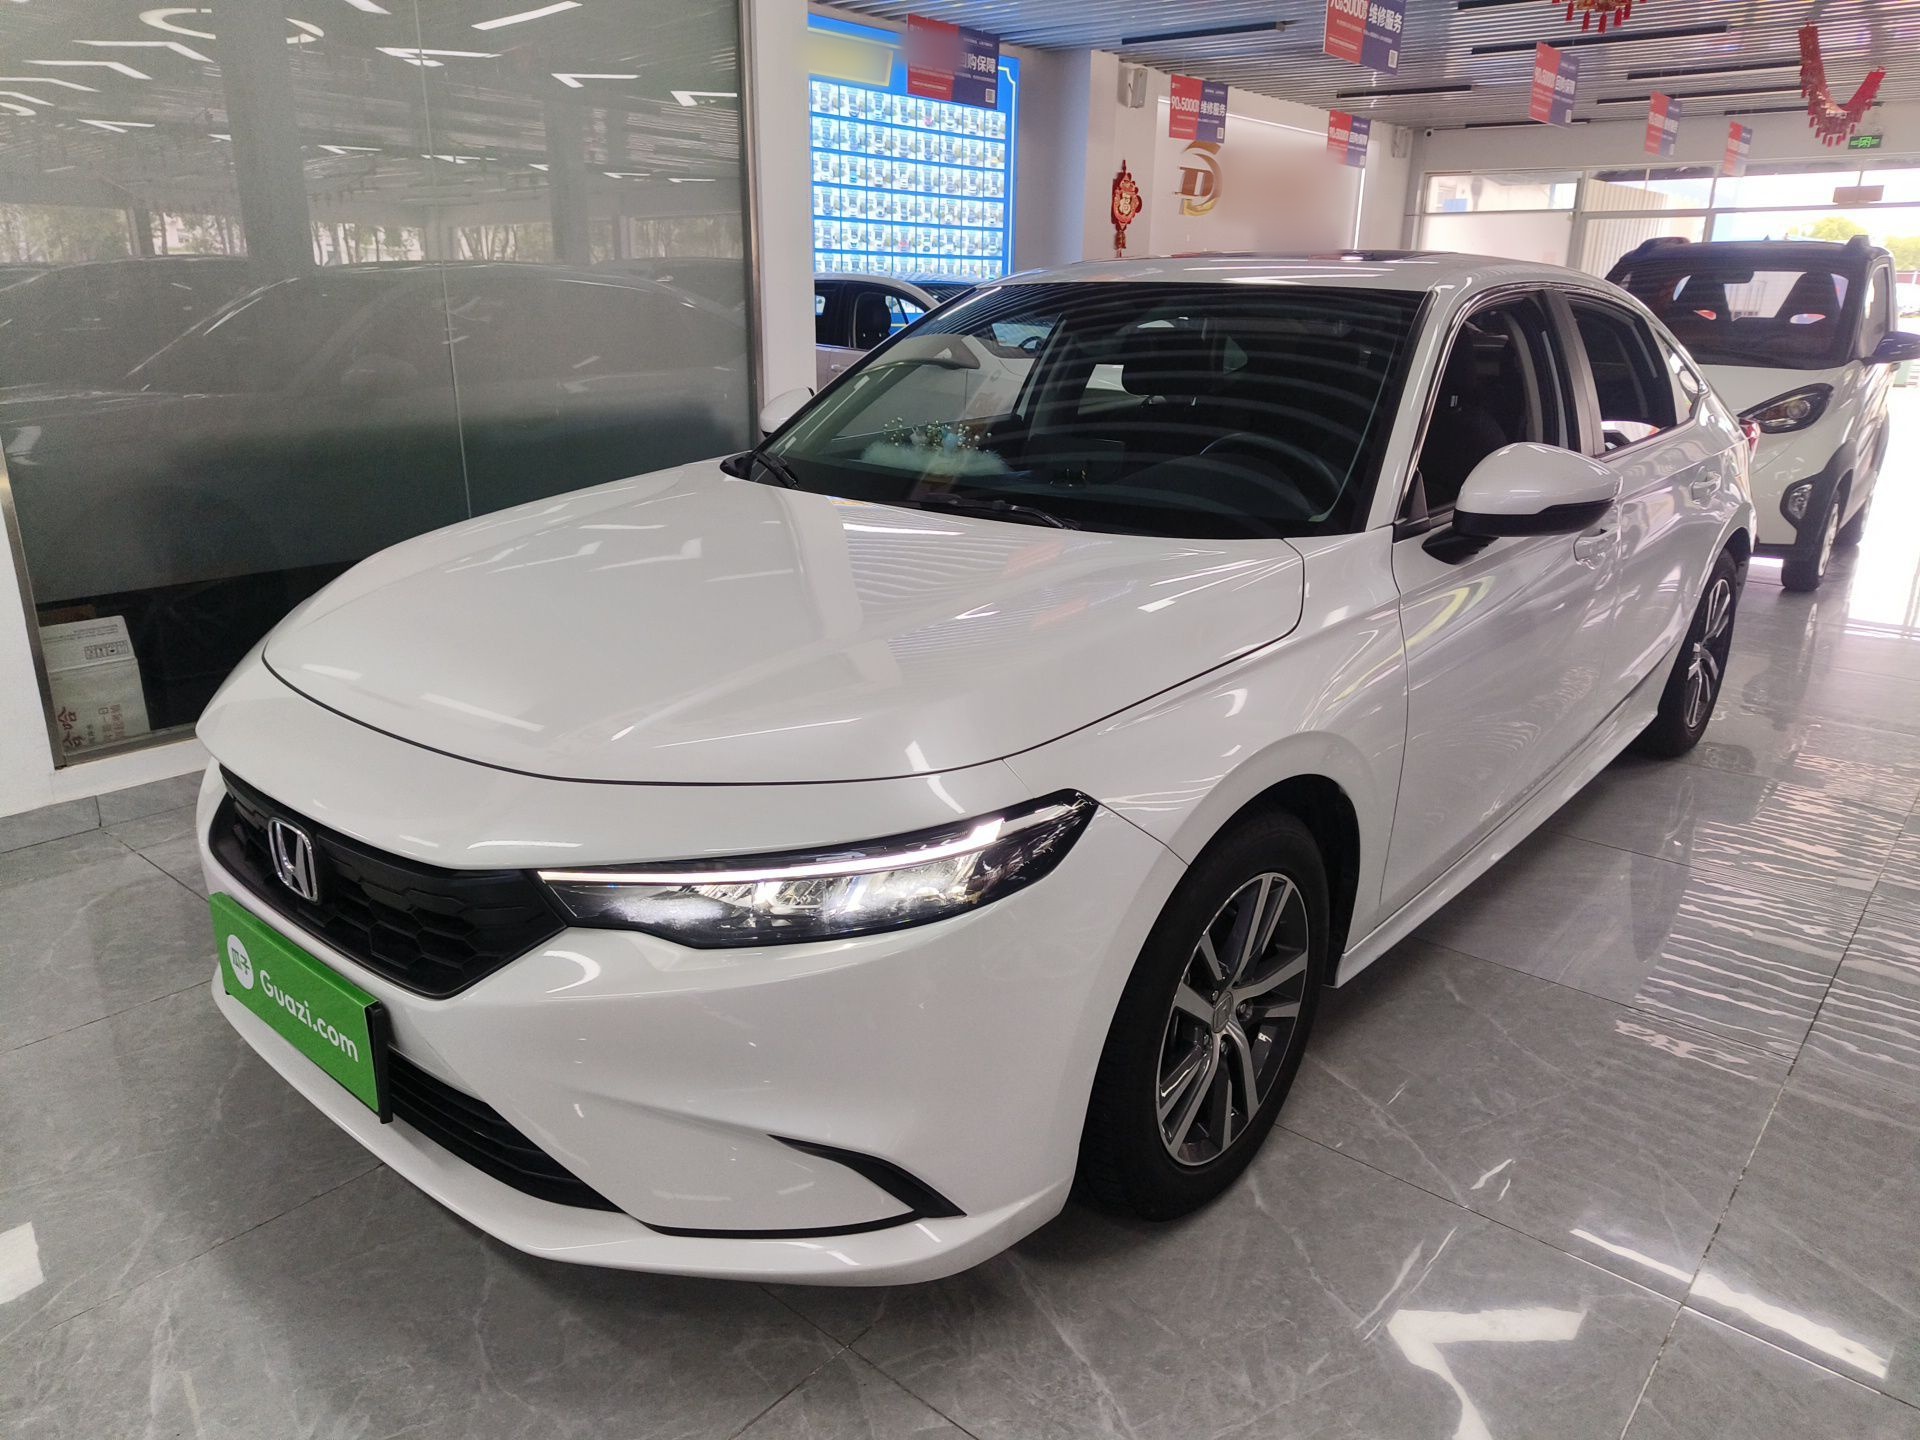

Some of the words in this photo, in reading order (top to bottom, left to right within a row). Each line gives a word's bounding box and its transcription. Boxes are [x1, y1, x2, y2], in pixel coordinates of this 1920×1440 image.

[1368, 2, 1402, 34] 维修服务
[260, 969, 359, 1063] Guazi.com
